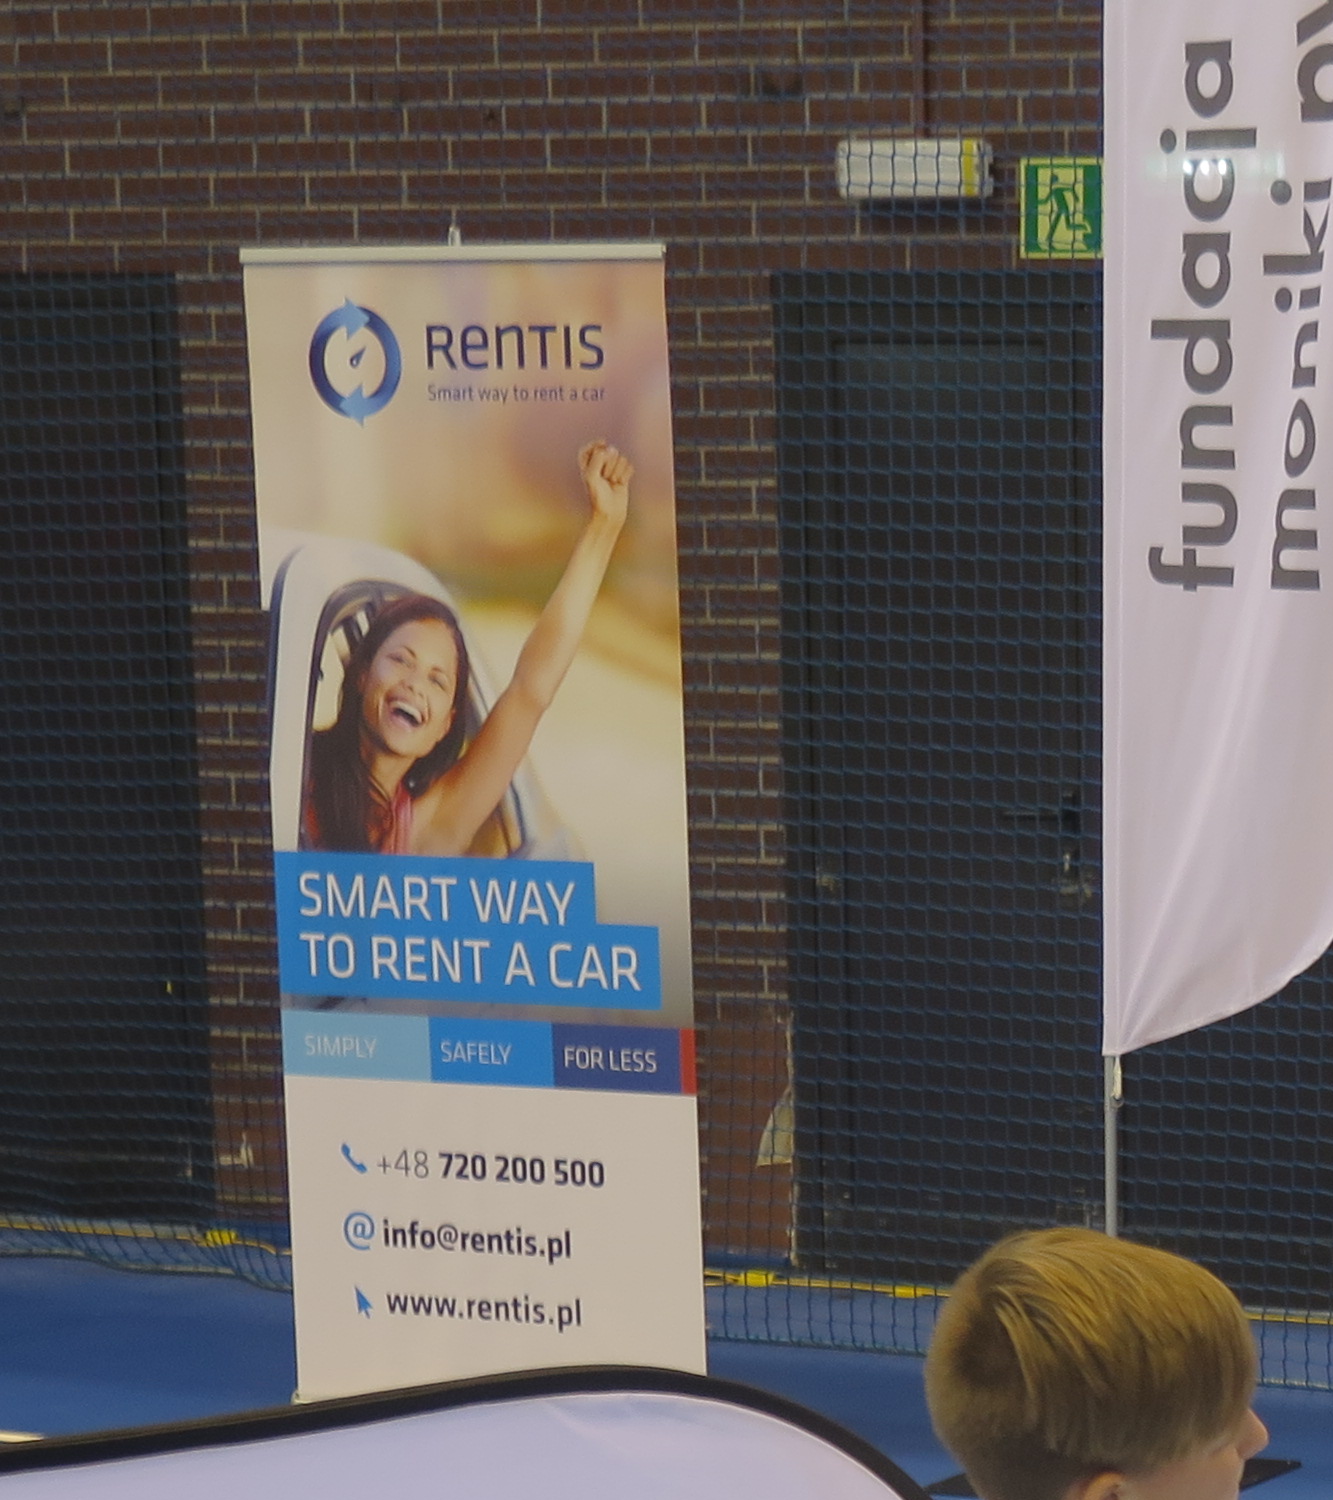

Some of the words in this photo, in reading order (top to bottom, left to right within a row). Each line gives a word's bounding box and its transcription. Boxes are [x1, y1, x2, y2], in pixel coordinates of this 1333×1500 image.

[1148, 39, 1257, 594] fundacja
[428, 384, 473, 401] Smart
[478, 387, 508, 404] way
[513, 386, 529, 401] to
[533, 386, 564, 401] rent
[570, 388, 578, 401] a
[582, 388, 605, 401] car
[1262, 178, 1333, 592] moniki
[299, 871, 458, 921] SMART
[470, 878, 576, 926] WAY
[299, 932, 356, 979] TO
[371, 934, 490, 984] RENT
[504, 942, 536, 987] A
[548, 943, 642, 992] CAR
[304, 1034, 378, 1060] SIMPLY
[440, 1041, 512, 1066] SAFELY
[564, 1045, 603, 1071] FOR
[609, 1048, 658, 1074] LESS
[377, 1149, 430, 1179] +48
[438, 1152, 488, 1181] 720
[495, 1155, 546, 1185] 200
[554, 1159, 605, 1188] 500
[382, 1218, 572, 1266] info@rentis.pl
[386, 1291, 583, 1334] www.rentis.pl
